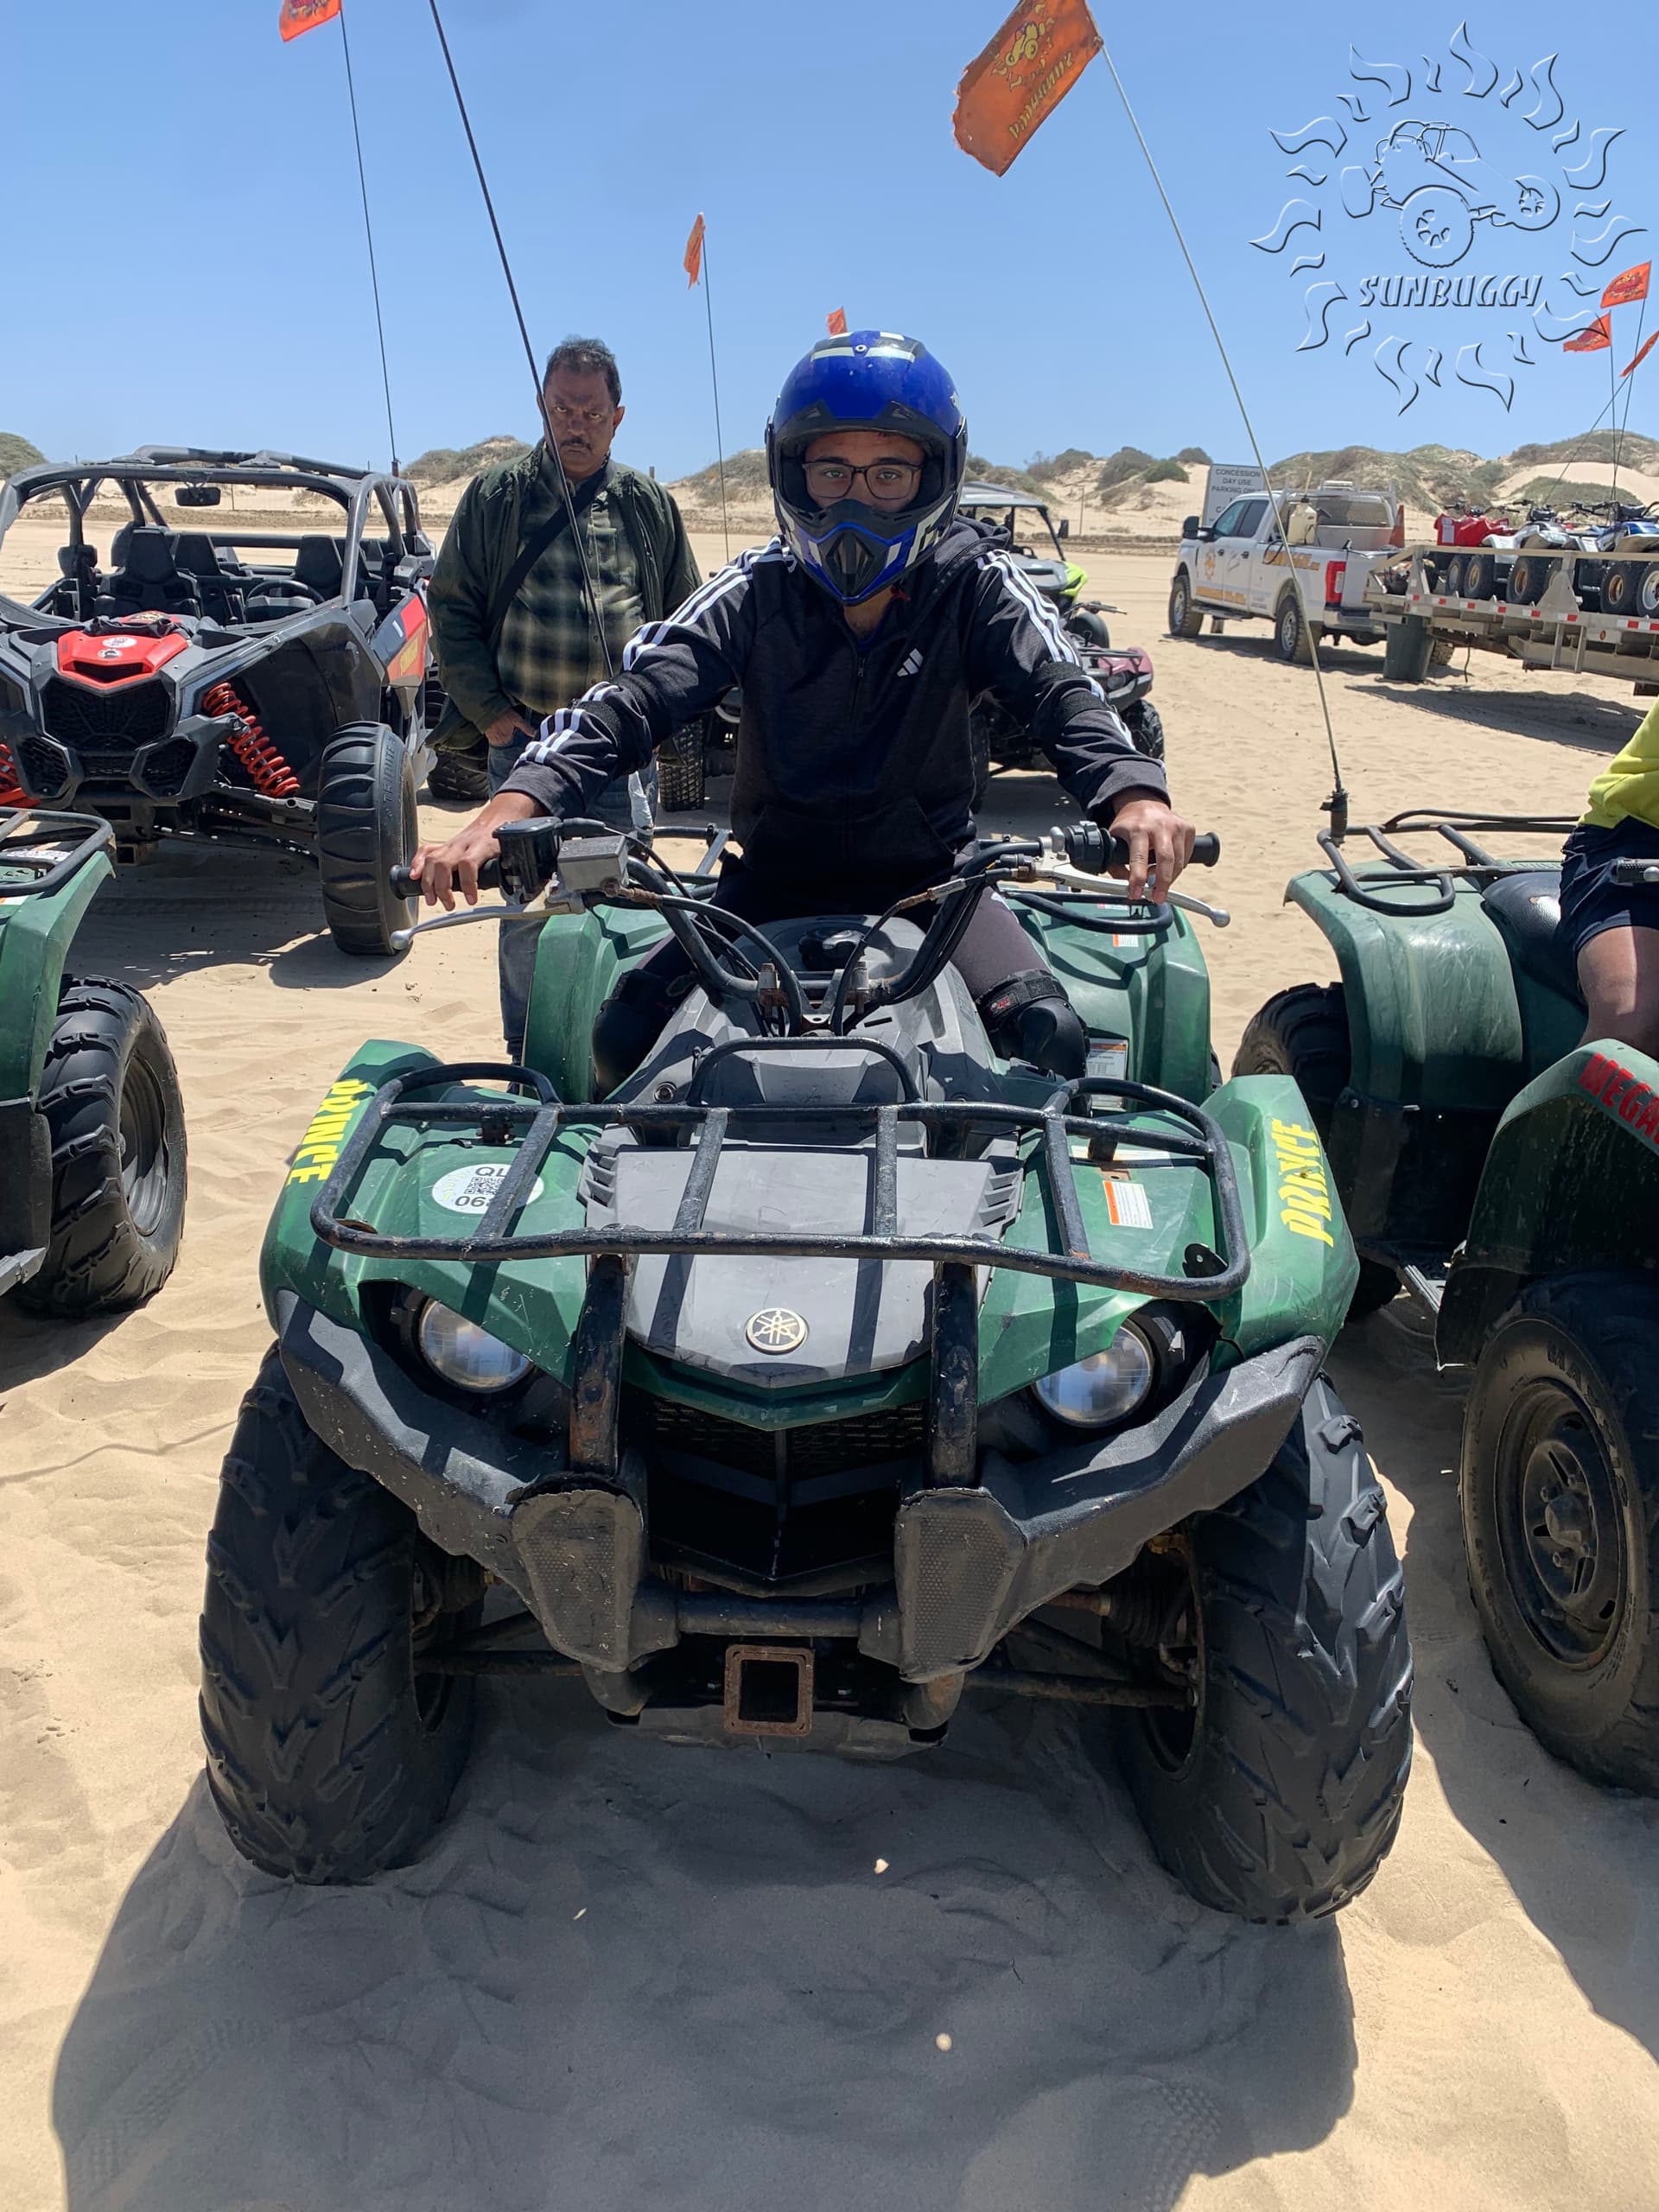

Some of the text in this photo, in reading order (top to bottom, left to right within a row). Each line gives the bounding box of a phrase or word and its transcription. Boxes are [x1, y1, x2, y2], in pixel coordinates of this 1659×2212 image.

[1216, 468, 1261, 478] CONCESSION
[286, 1077, 367, 1186] PRINCE
[1578, 1052, 1659, 1145] MEGA
[1271, 1119, 1334, 1249] PRINCE
